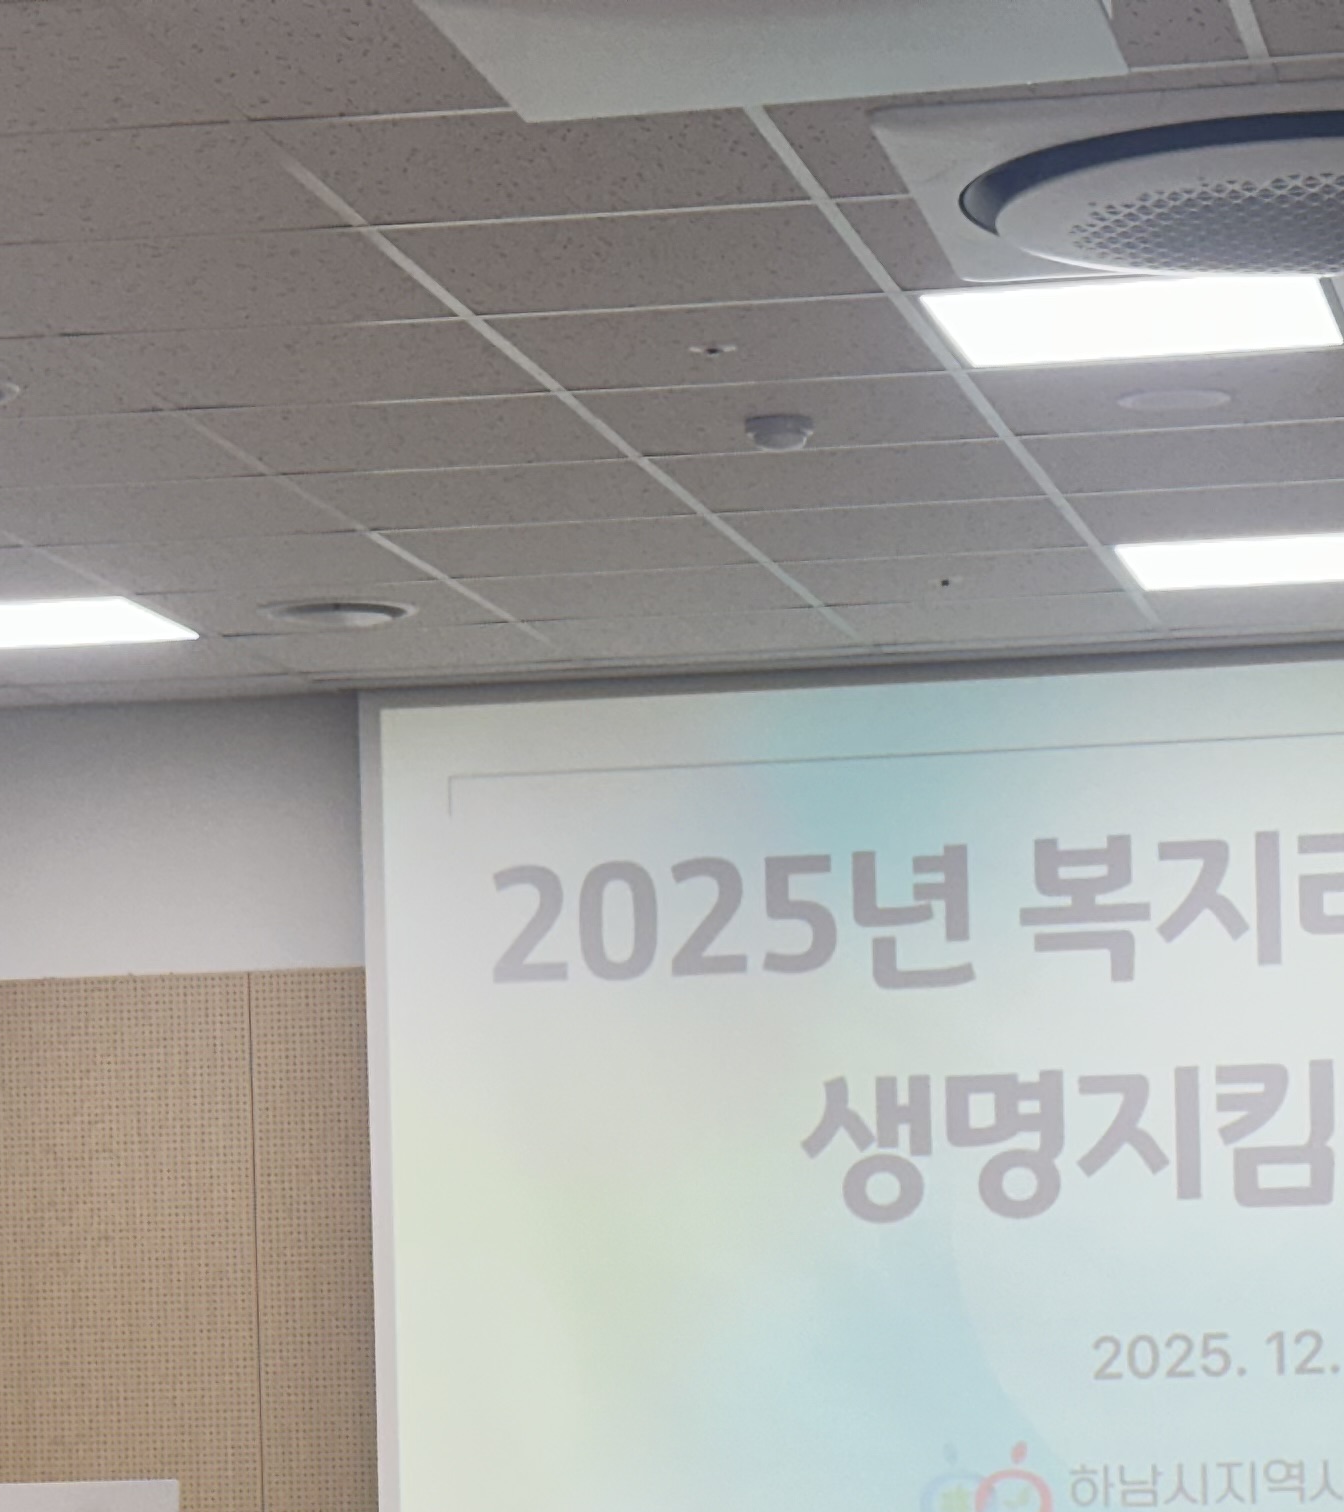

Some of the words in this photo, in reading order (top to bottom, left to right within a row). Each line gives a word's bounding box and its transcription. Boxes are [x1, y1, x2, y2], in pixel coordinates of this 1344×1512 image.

[492, 843, 976, 990] 2025년
[1091, 1332, 1248, 1381] 2025.
[1263, 1329, 1342, 1377] 12.
